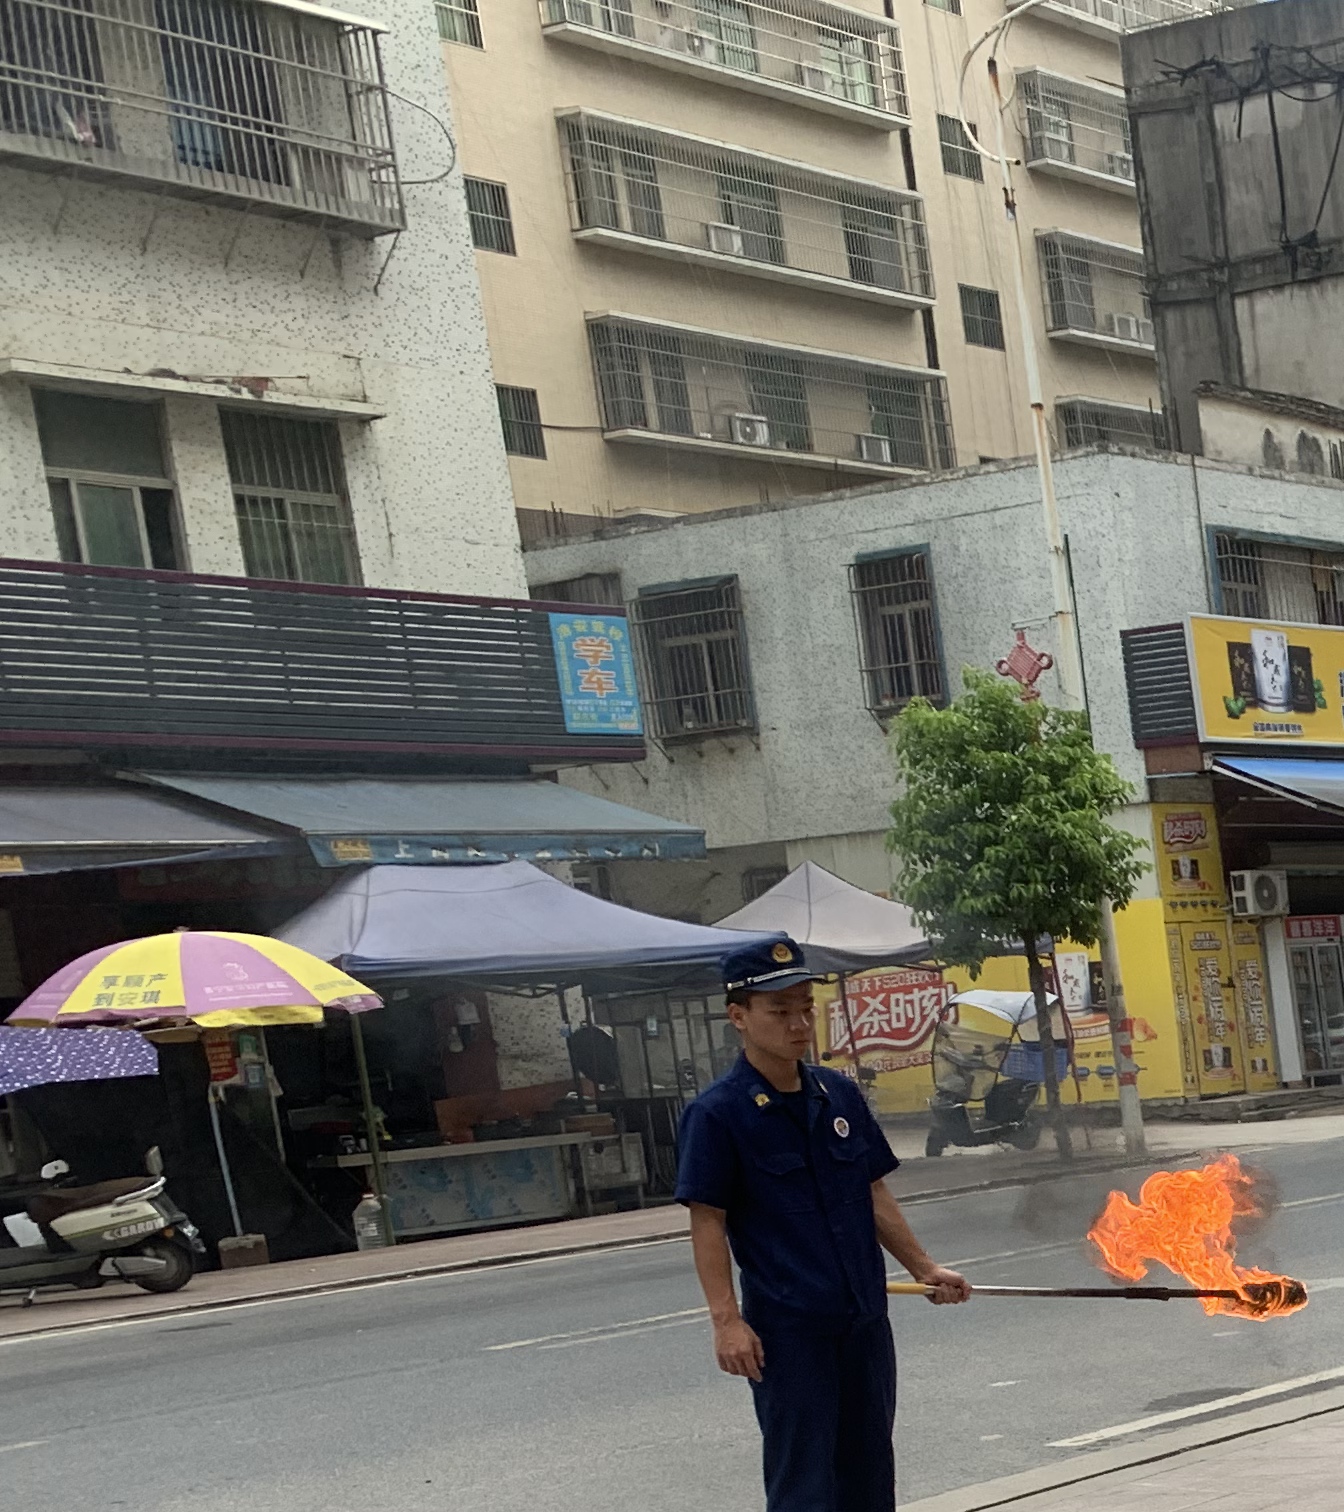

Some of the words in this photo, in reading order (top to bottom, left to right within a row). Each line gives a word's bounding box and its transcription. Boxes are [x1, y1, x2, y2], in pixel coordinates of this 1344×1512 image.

[572, 636, 619, 698] 学车
[95, 990, 162, 1006] 到安琪
[829, 984, 957, 1053] 秒杀时刻
